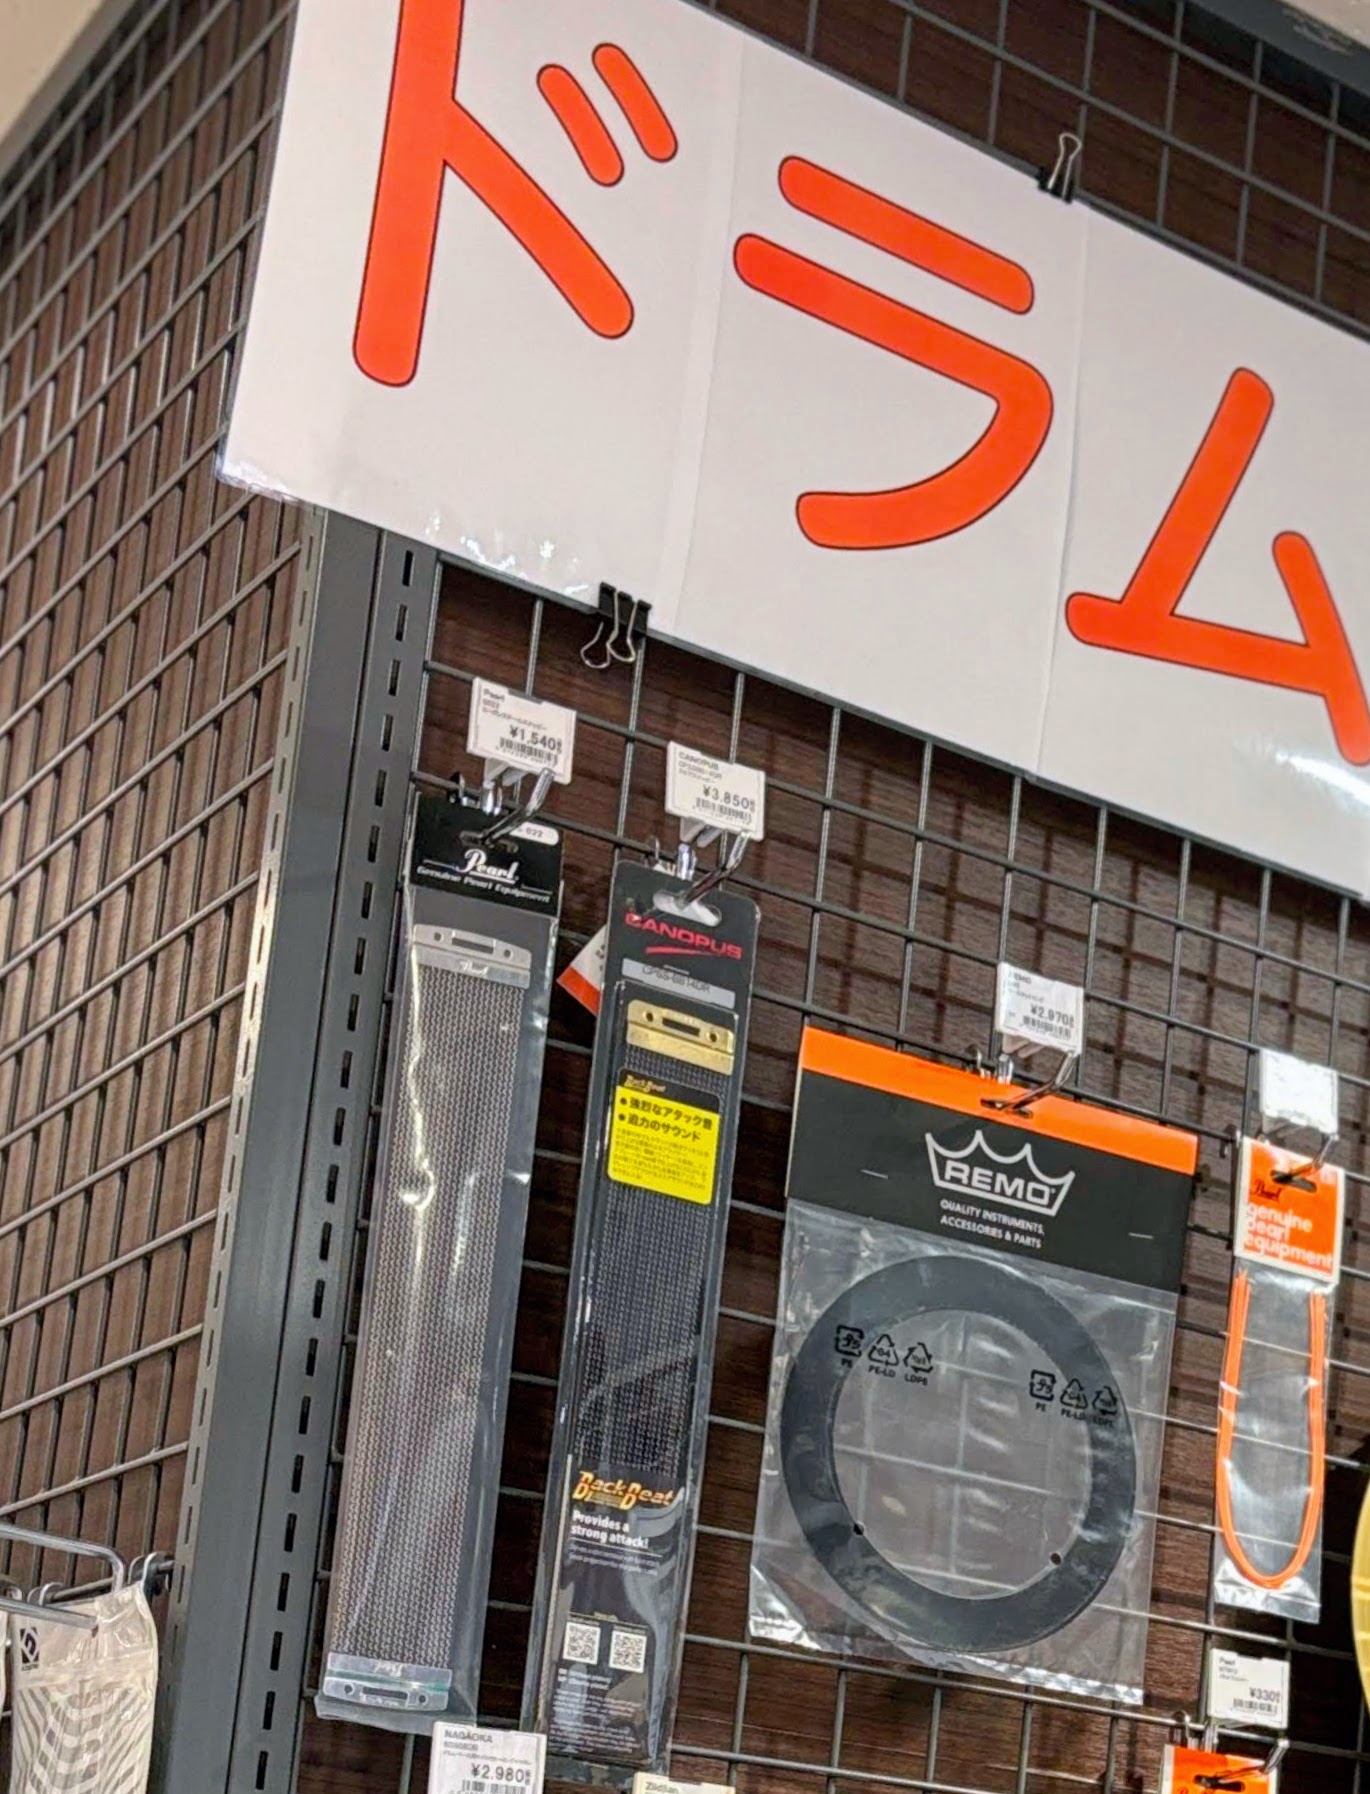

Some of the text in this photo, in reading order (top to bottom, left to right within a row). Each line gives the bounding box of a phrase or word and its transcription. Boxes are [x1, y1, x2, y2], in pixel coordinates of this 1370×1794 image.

[463, 849, 519, 882] Pearl
[624, 912, 743, 960] CANOPUS
[943, 1160, 1052, 1204] REMO
[940, 1200, 981, 1219] QUALITY
[1247, 1203, 1313, 1233] genuine
[940, 1216, 1002, 1241] ACCESSORIES
[1013, 1233, 1042, 1248] PARTS
[1242, 1233, 1334, 1269] equipment
[571, 1523, 649, 1549] strong attack!
[572, 1510, 619, 1531] Provides
[471, 1762, 526, 1785] ¥2,980
